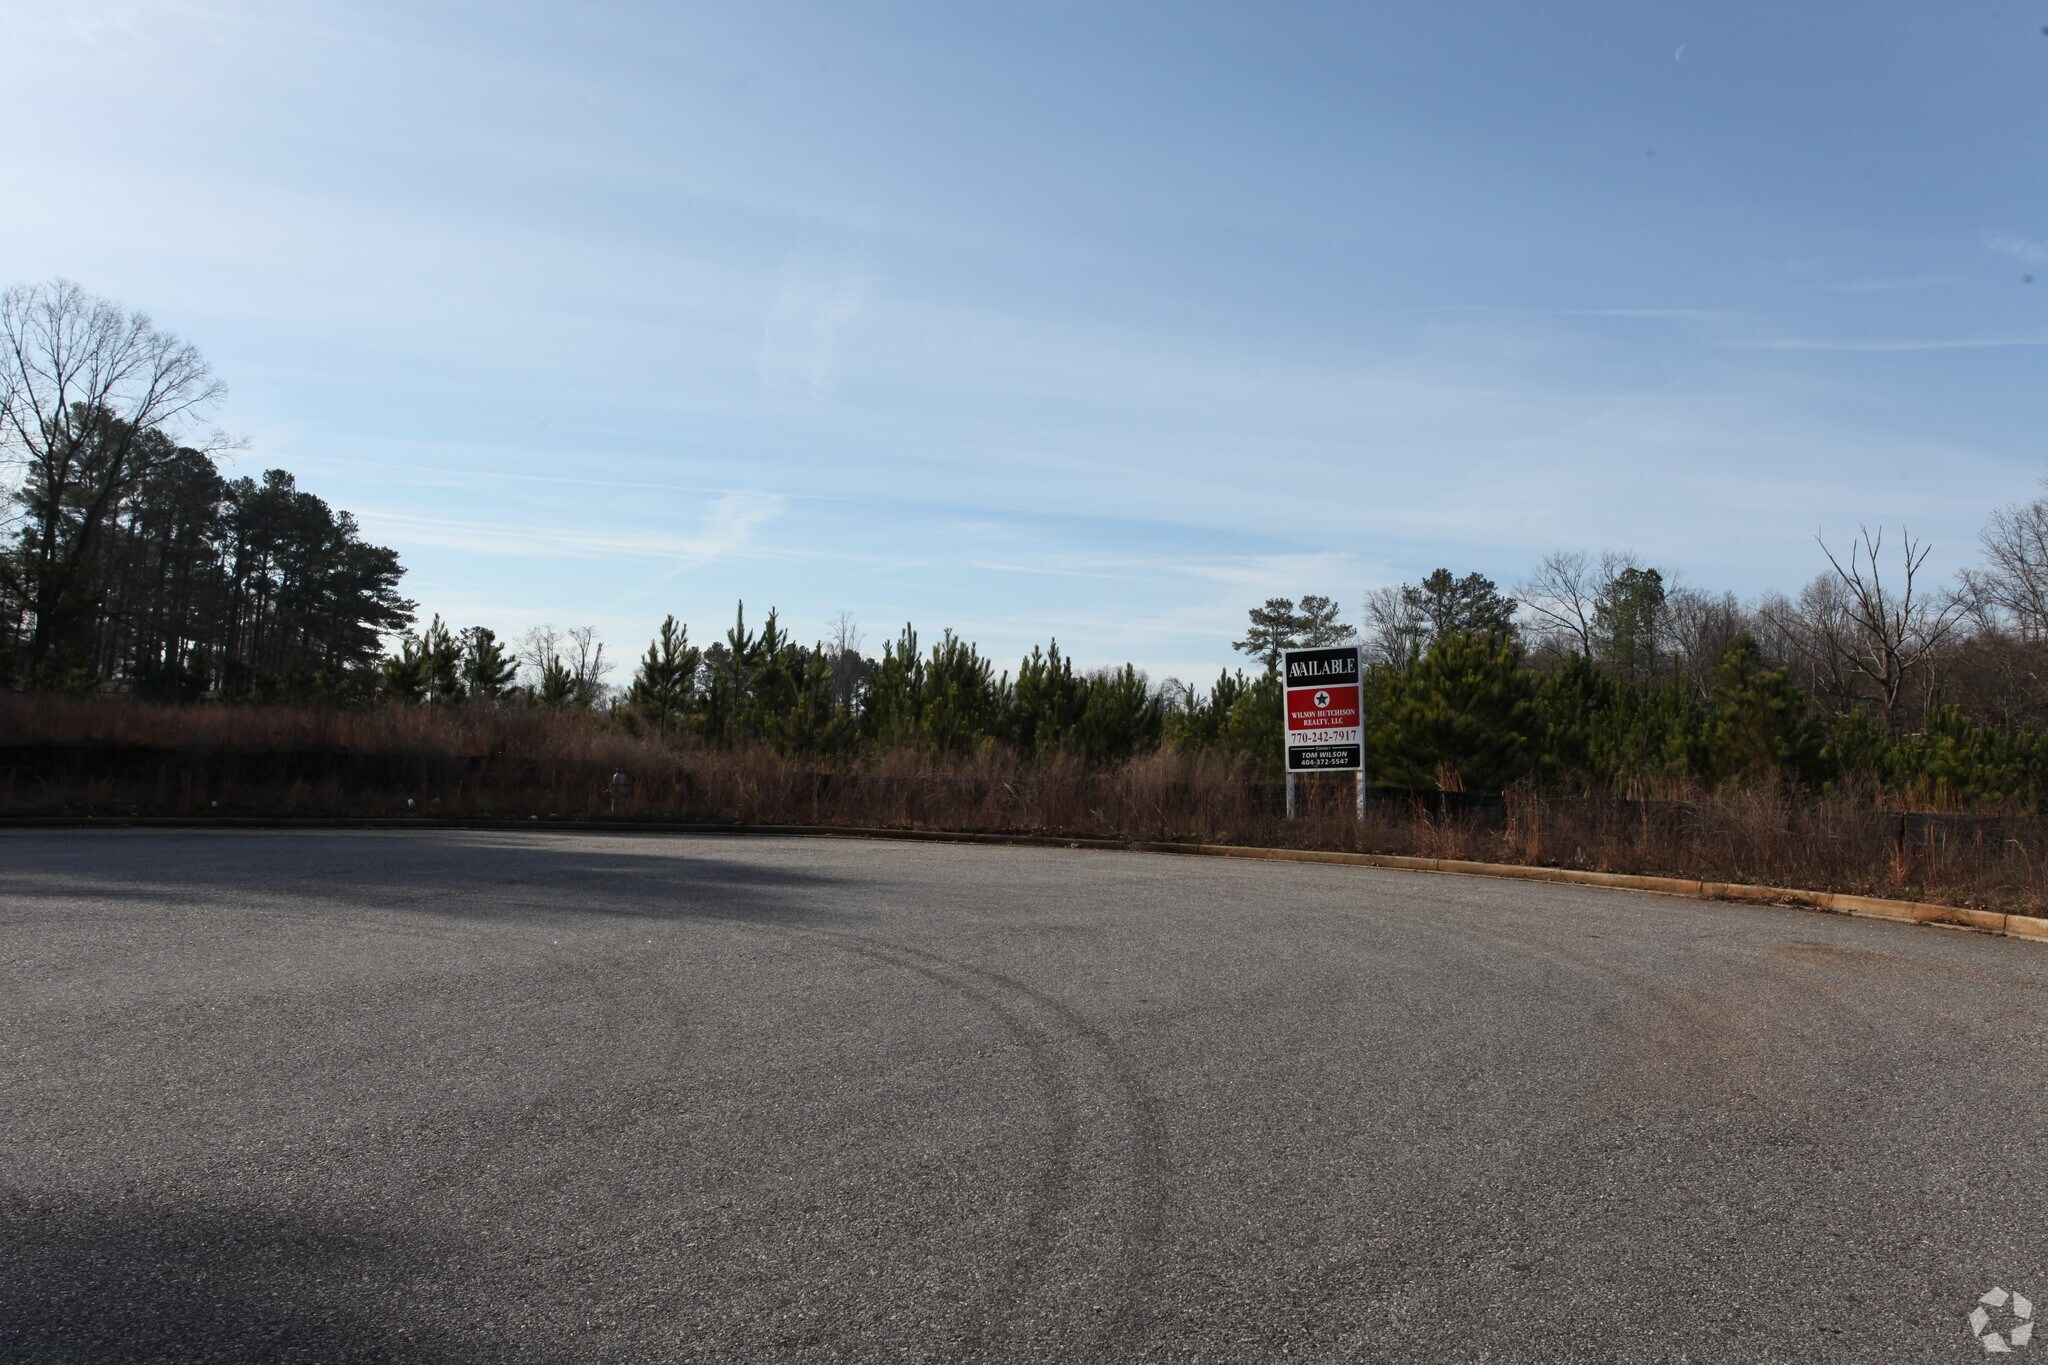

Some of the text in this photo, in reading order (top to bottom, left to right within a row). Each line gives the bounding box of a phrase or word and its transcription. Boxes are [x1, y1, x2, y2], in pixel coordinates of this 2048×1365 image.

[1289, 658, 1356, 678] AVAILABLE
[1291, 708, 1355, 719] WILSON HUTCHISON
[1331, 717, 1344, 725] LLC
[1291, 730, 1357, 743] 770-242-7917
